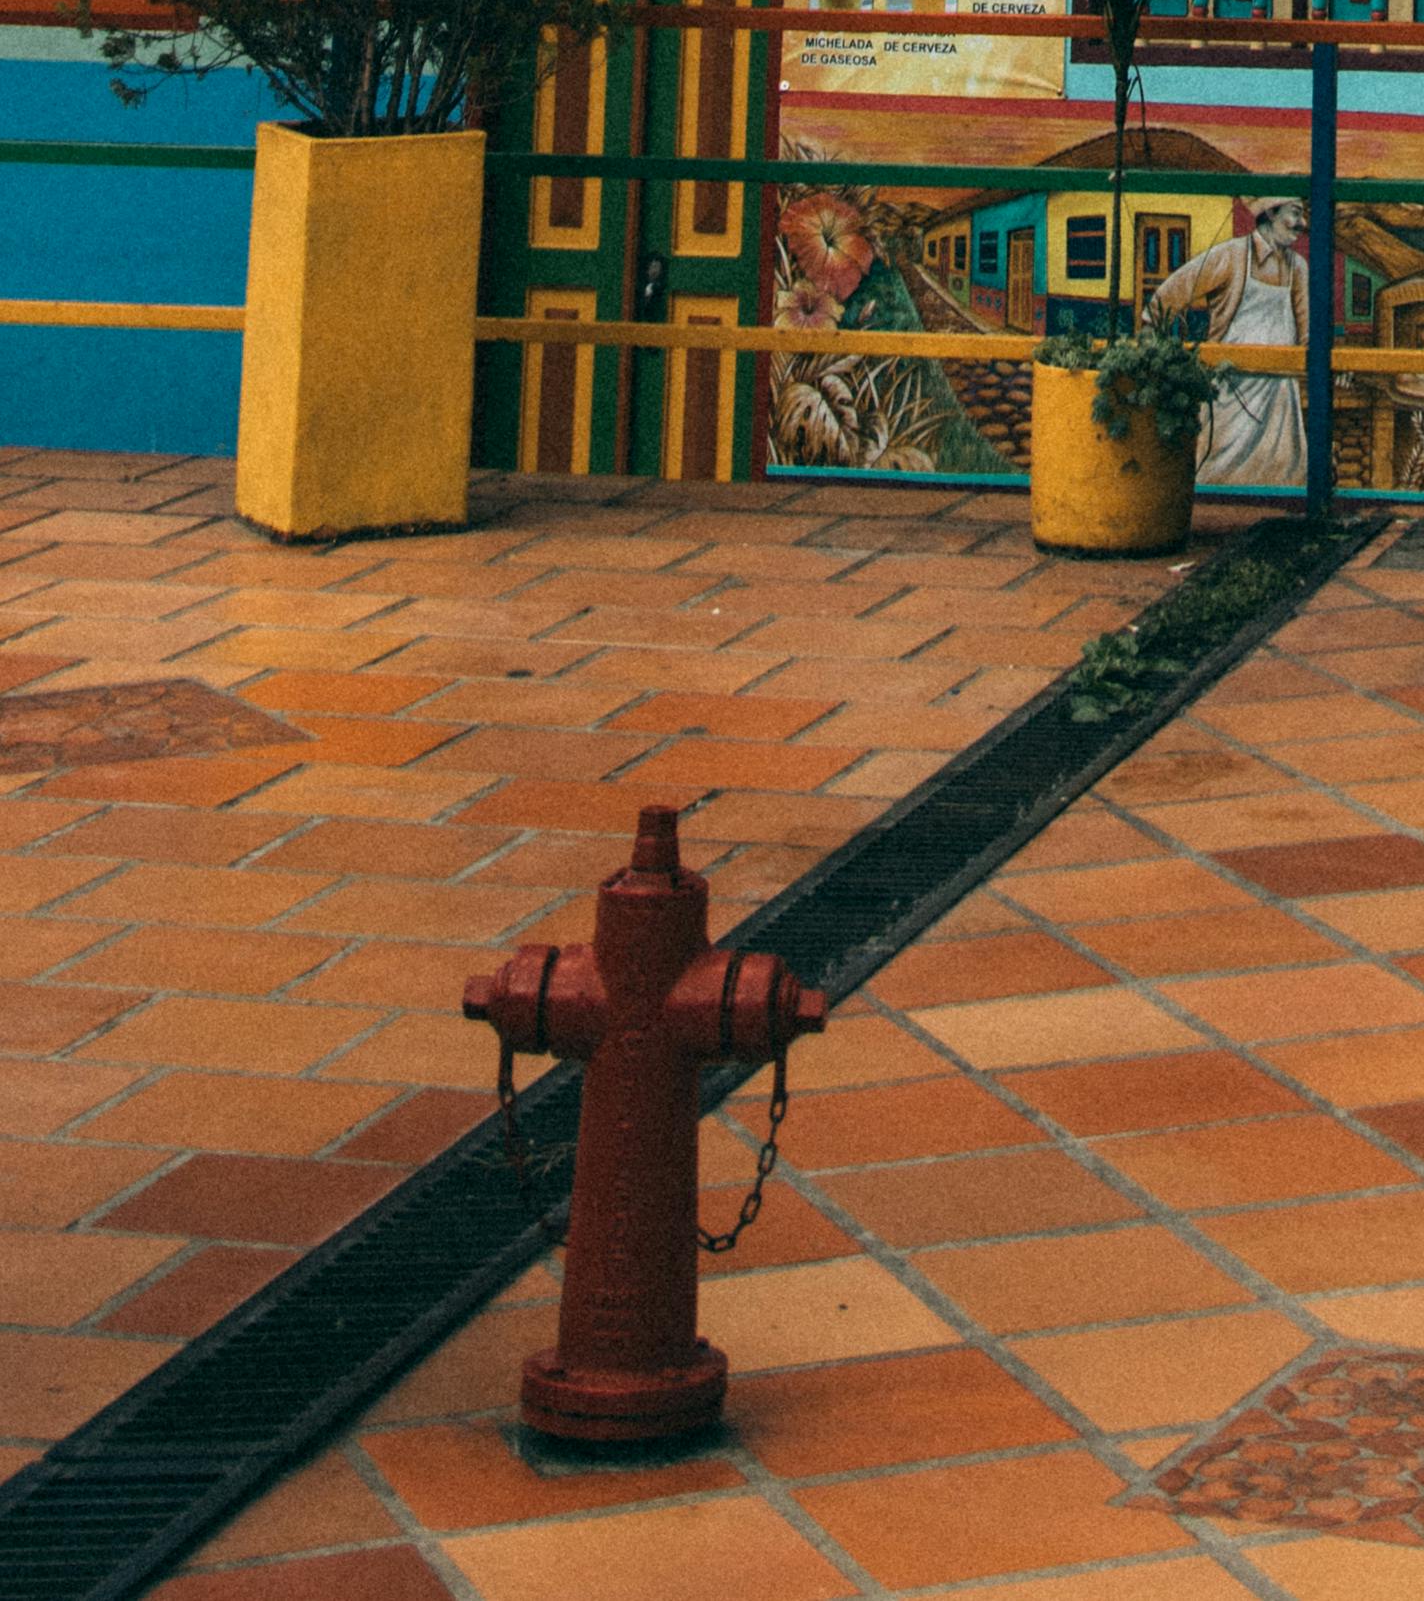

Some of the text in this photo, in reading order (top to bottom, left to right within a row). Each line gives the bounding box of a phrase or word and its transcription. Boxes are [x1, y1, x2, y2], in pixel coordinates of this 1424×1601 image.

[972, 2, 1047, 15] DE CERVEZA
[804, 37, 874, 50] MICHELADA
[883, 40, 958, 54] DE CERVEZA
[801, 53, 878, 67] DE GASEOSA
